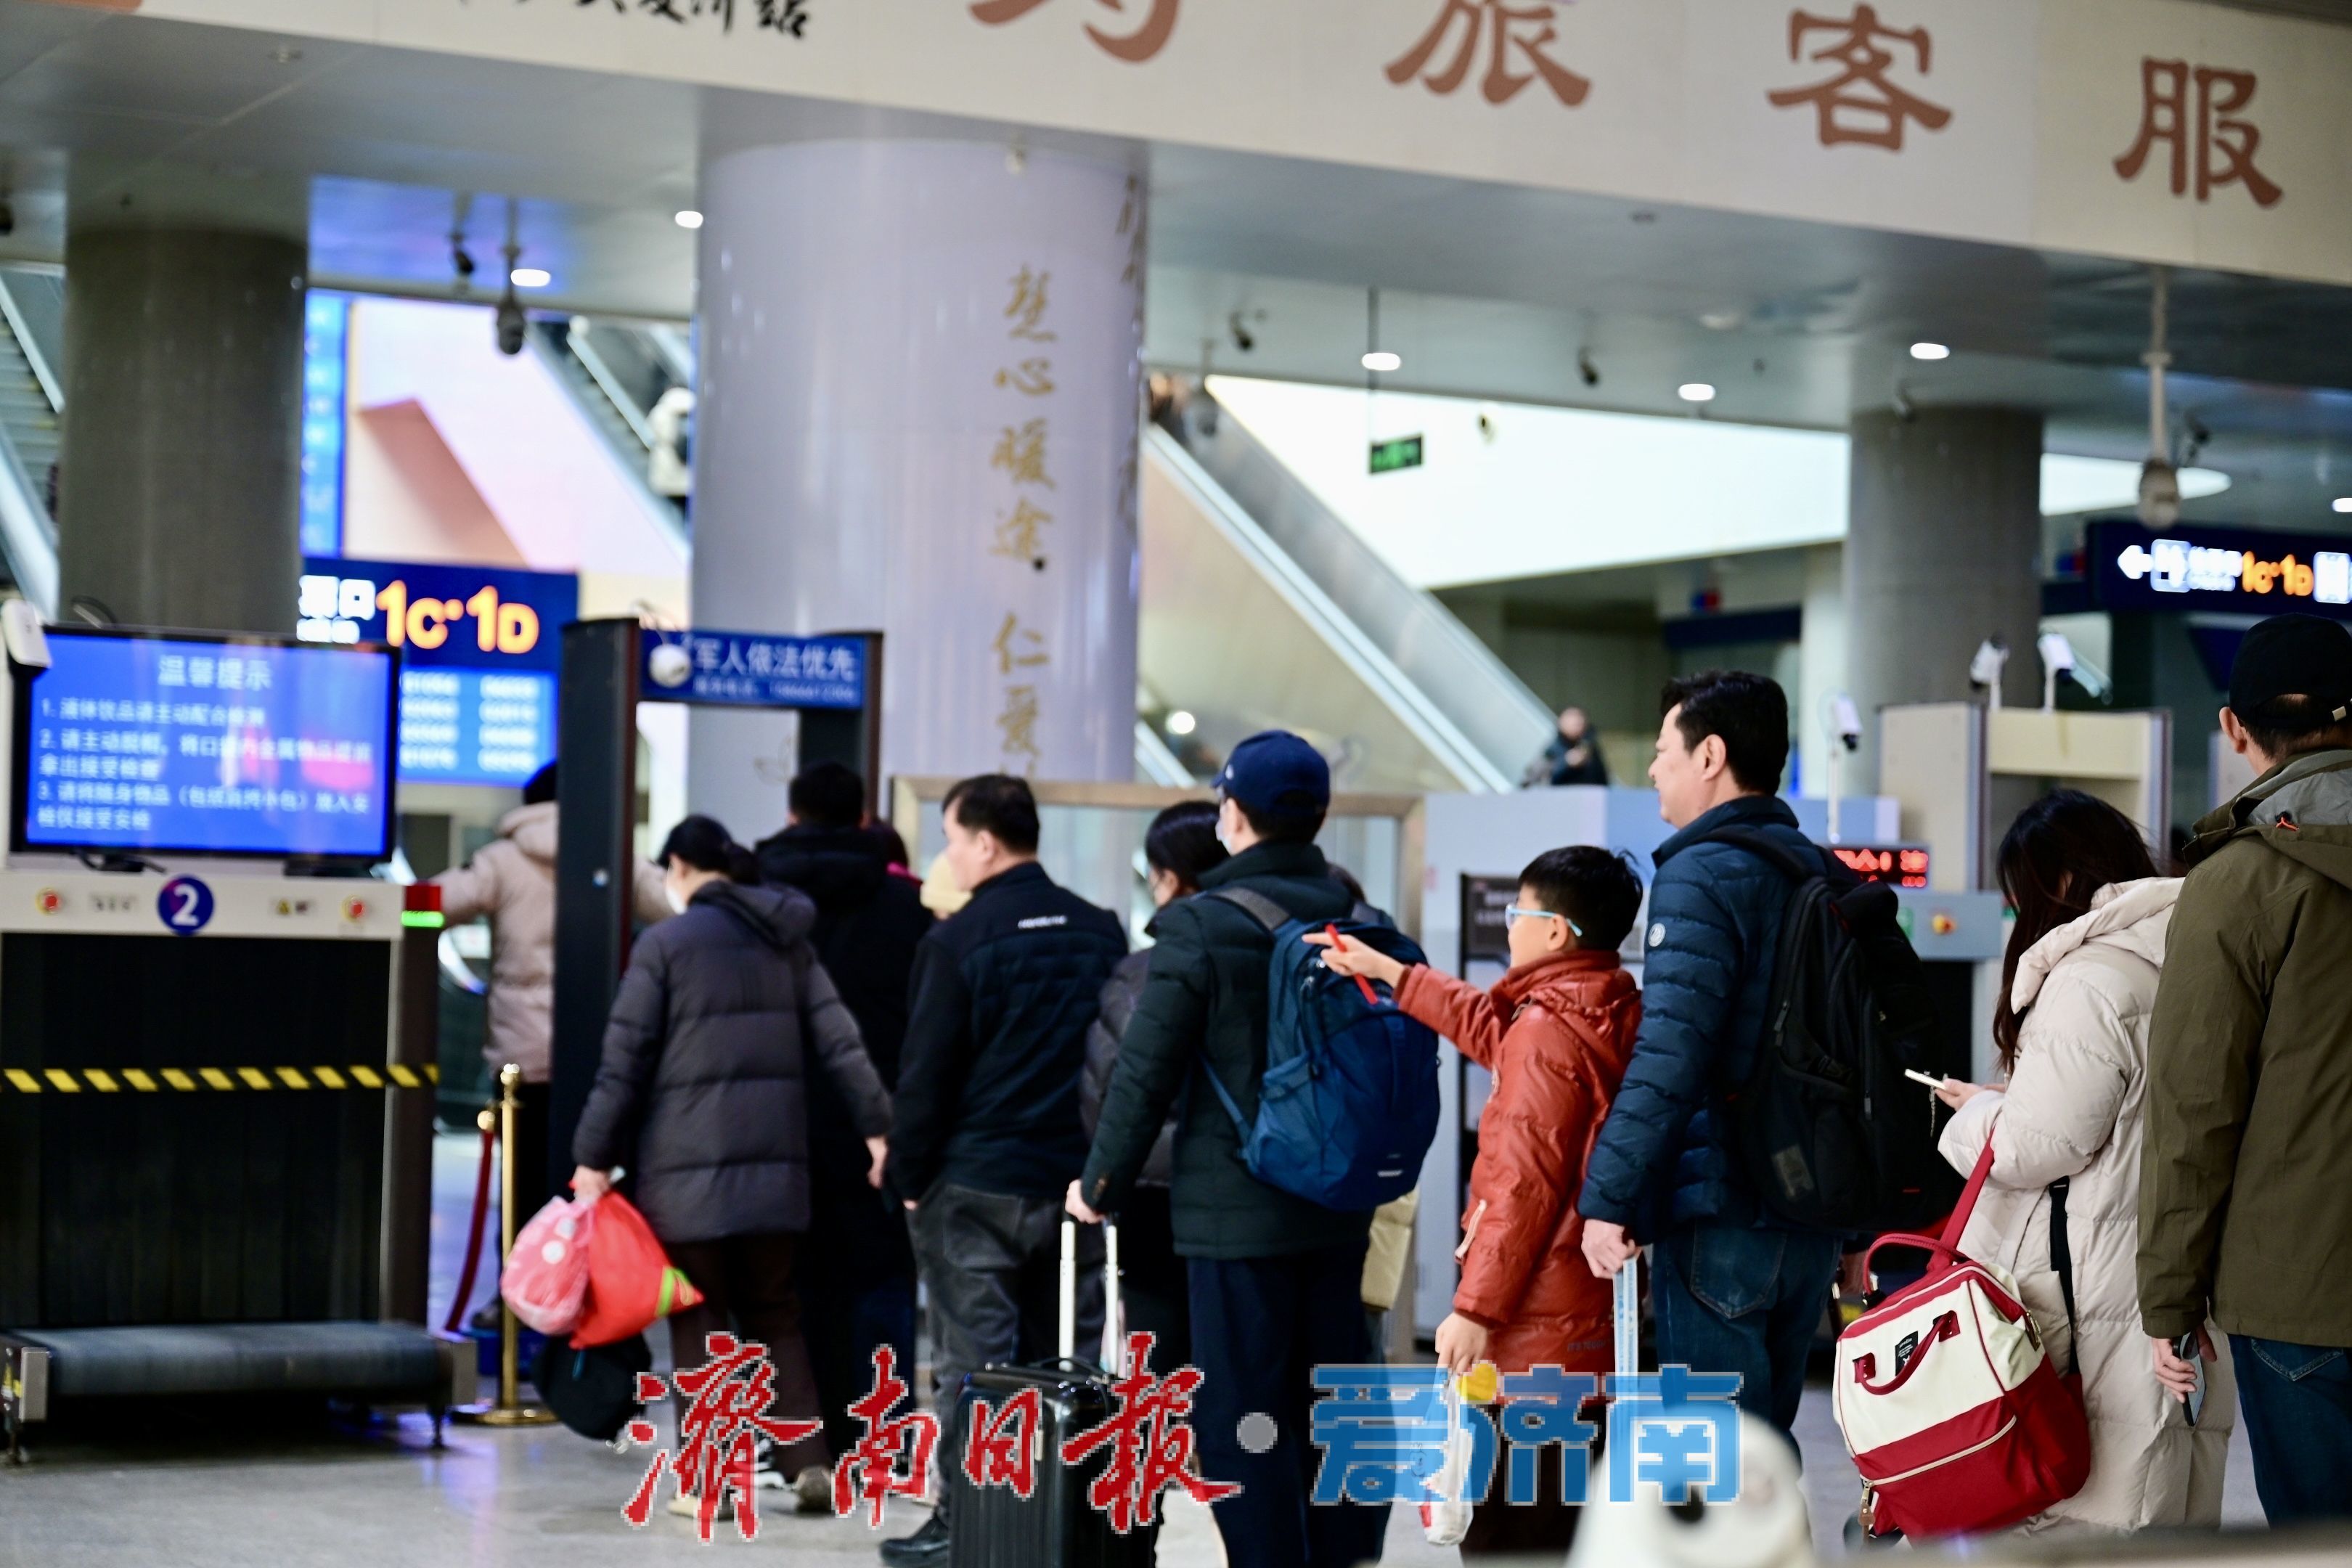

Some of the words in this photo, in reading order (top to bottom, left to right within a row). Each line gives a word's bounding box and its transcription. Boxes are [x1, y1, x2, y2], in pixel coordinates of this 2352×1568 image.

[158, 654, 273, 692] 温馨提示
[171, 883, 199, 927] 2
